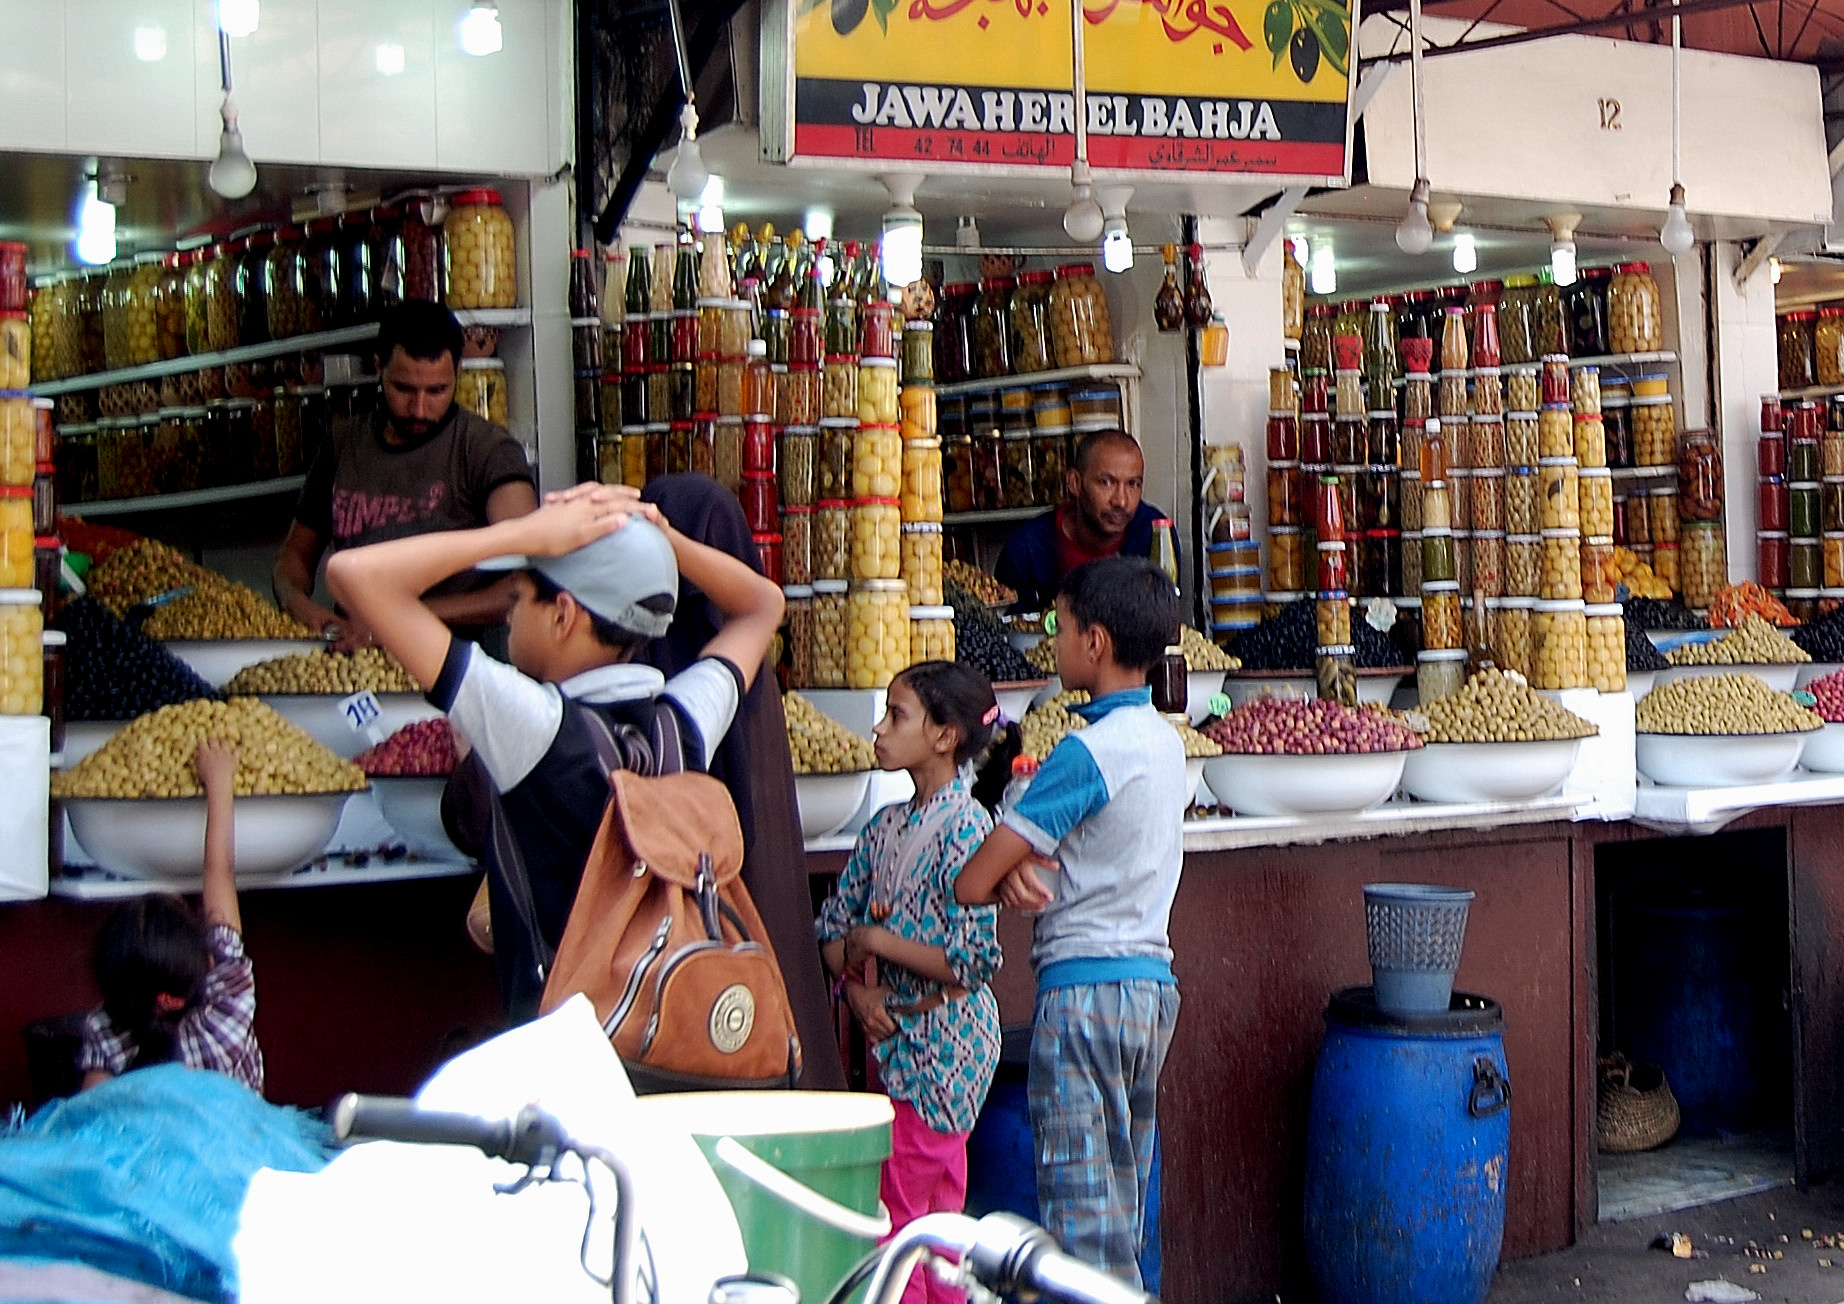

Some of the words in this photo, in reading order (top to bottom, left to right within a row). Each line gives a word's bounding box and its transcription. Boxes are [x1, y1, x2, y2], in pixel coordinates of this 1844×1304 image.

[852, 83, 1076, 135] JAWAHER
[1086, 96, 1138, 137] EL
[1140, 97, 1282, 141] BAHJA
[1597, 97, 1622, 131] 12
